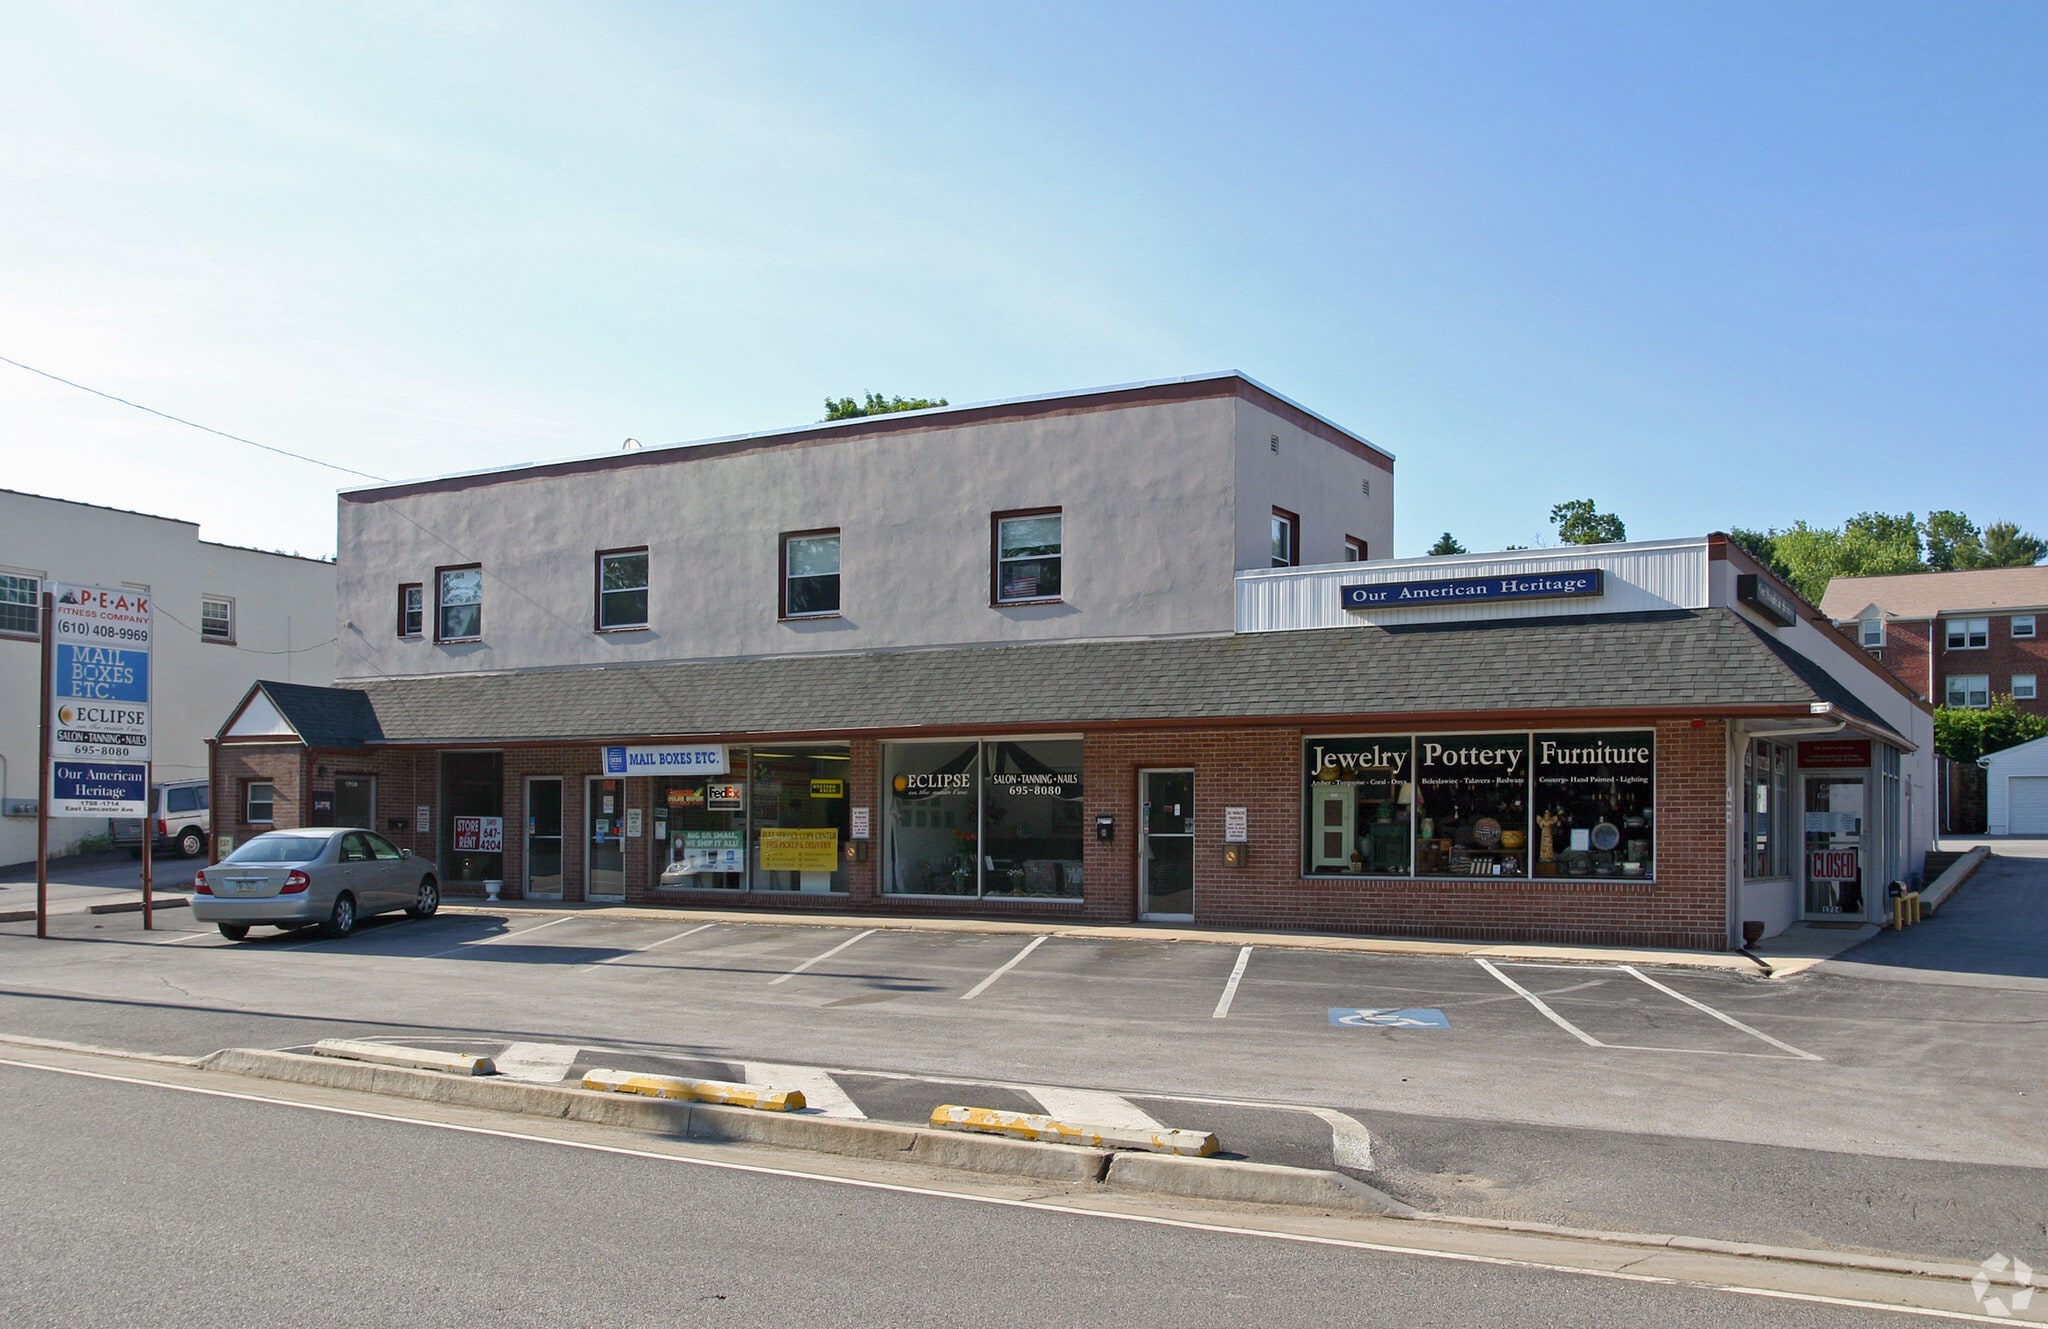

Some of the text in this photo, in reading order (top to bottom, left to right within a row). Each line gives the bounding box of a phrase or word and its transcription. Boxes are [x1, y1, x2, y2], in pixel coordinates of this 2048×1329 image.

[1353, 578, 1587, 602] Our American Heritage
[58, 607, 150, 624] FITNESS COMPANY
[58, 620, 148, 641] (610) 408-9969
[72, 646, 124, 666] MAIL
[72, 663, 134, 684] BOXES
[77, 708, 144, 725] ECLIPSE
[58, 731, 145, 746] SALON TANNING NAILS
[74, 745, 129, 756] 695-8080
[1423, 743, 1523, 773] Pottery
[1540, 740, 1649, 764] Furniture
[629, 752, 719, 765] MAIL BOXES ETC.
[1311, 745, 1407, 776] Jewelry
[58, 767, 142, 782] Our American
[908, 774, 970, 788] ECLIPSE
[993, 774, 1077, 784] SALON TANNING NAILS
[75, 783, 126, 799] Heritage
[709, 786, 740, 798] FedEx
[1009, 786, 1062, 795] 695-8080
[457, 820, 479, 832] STORE
[483, 828, 500, 838] 647-
[459, 837, 477, 848] RENT
[481, 841, 501, 850] 4204
[1813, 852, 1854, 878] CLOSED
